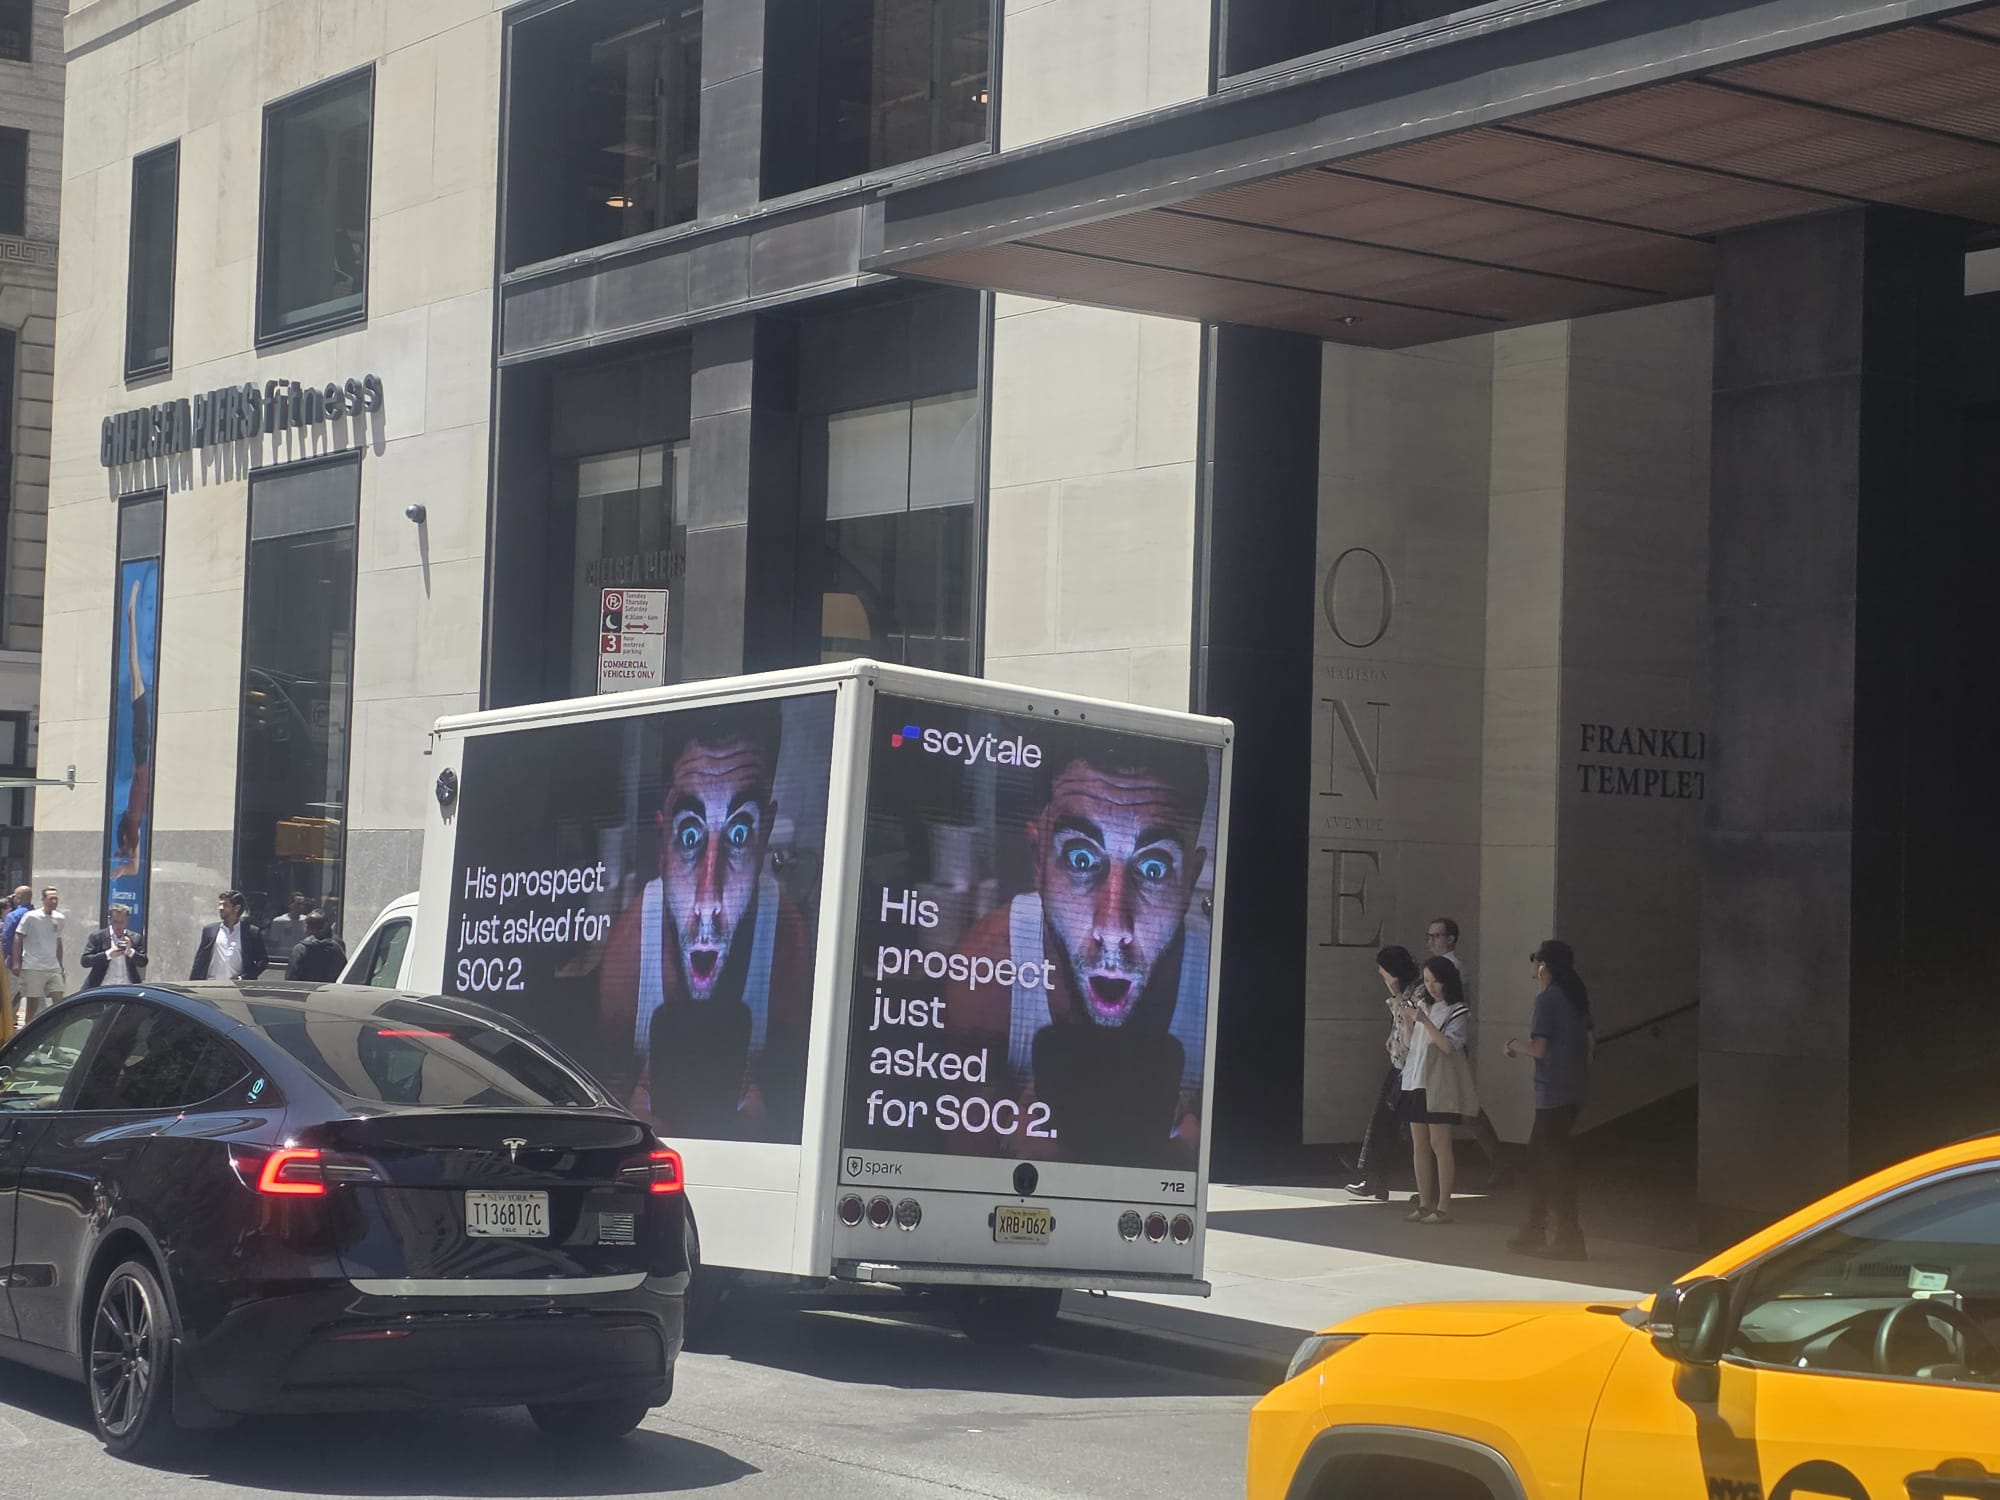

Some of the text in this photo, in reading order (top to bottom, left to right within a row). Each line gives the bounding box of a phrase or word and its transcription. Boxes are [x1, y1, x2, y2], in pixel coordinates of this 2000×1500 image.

[101, 373, 385, 467] CHELSEA PIERS fitness
[606, 635, 617, 652] 3
[602, 660, 649, 669] COMMERCIAL
[602, 670, 656, 679] VEHICLES ONLY
[922, 727, 1043, 769] scytale
[464, 861, 606, 905] His prospect
[880, 886, 940, 929] His
[457, 907, 611, 953] just asked for
[456, 957, 504, 992] SOC
[876, 945, 1057, 991] prospect
[869, 987, 946, 1031] just
[869, 1042, 988, 1083] asked
[866, 1089, 1058, 1139] for SOC 2.
[864, 1161, 904, 1175] spark
[1160, 1181, 1185, 1193] 712
[473, 1202, 542, 1226] T136812C
[487, 1193, 529, 1202] NEW YORK
